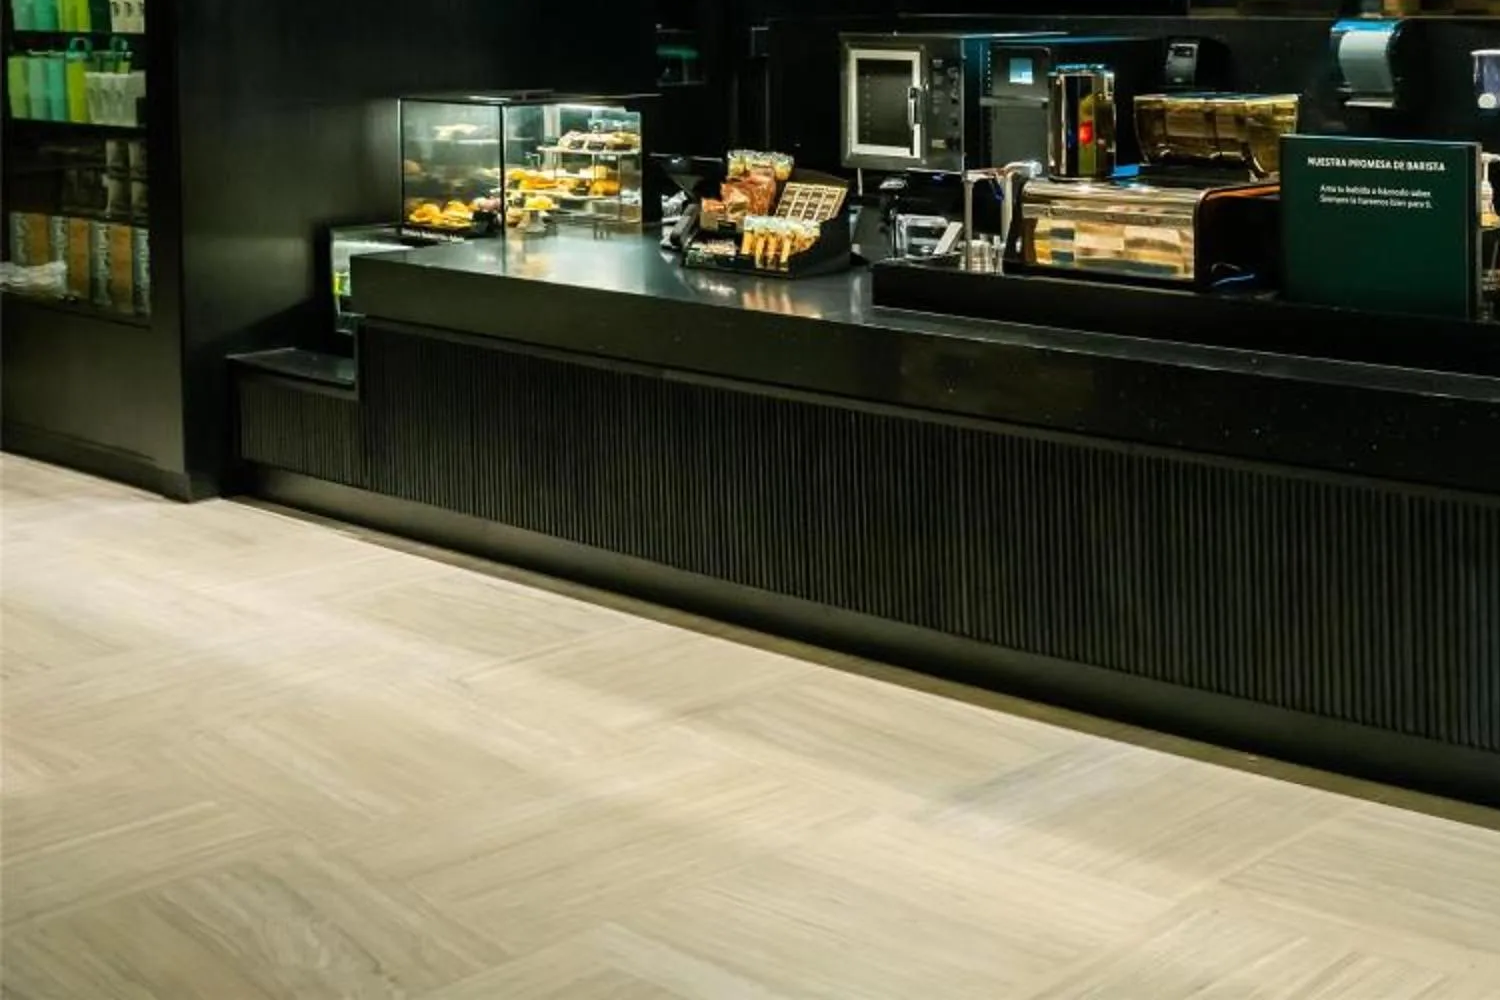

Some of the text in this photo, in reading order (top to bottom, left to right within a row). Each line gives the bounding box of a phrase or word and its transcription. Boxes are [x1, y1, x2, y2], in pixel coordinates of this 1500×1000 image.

[1307, 156, 1445, 171] NUESTRA PROMESA DE BARISTA
